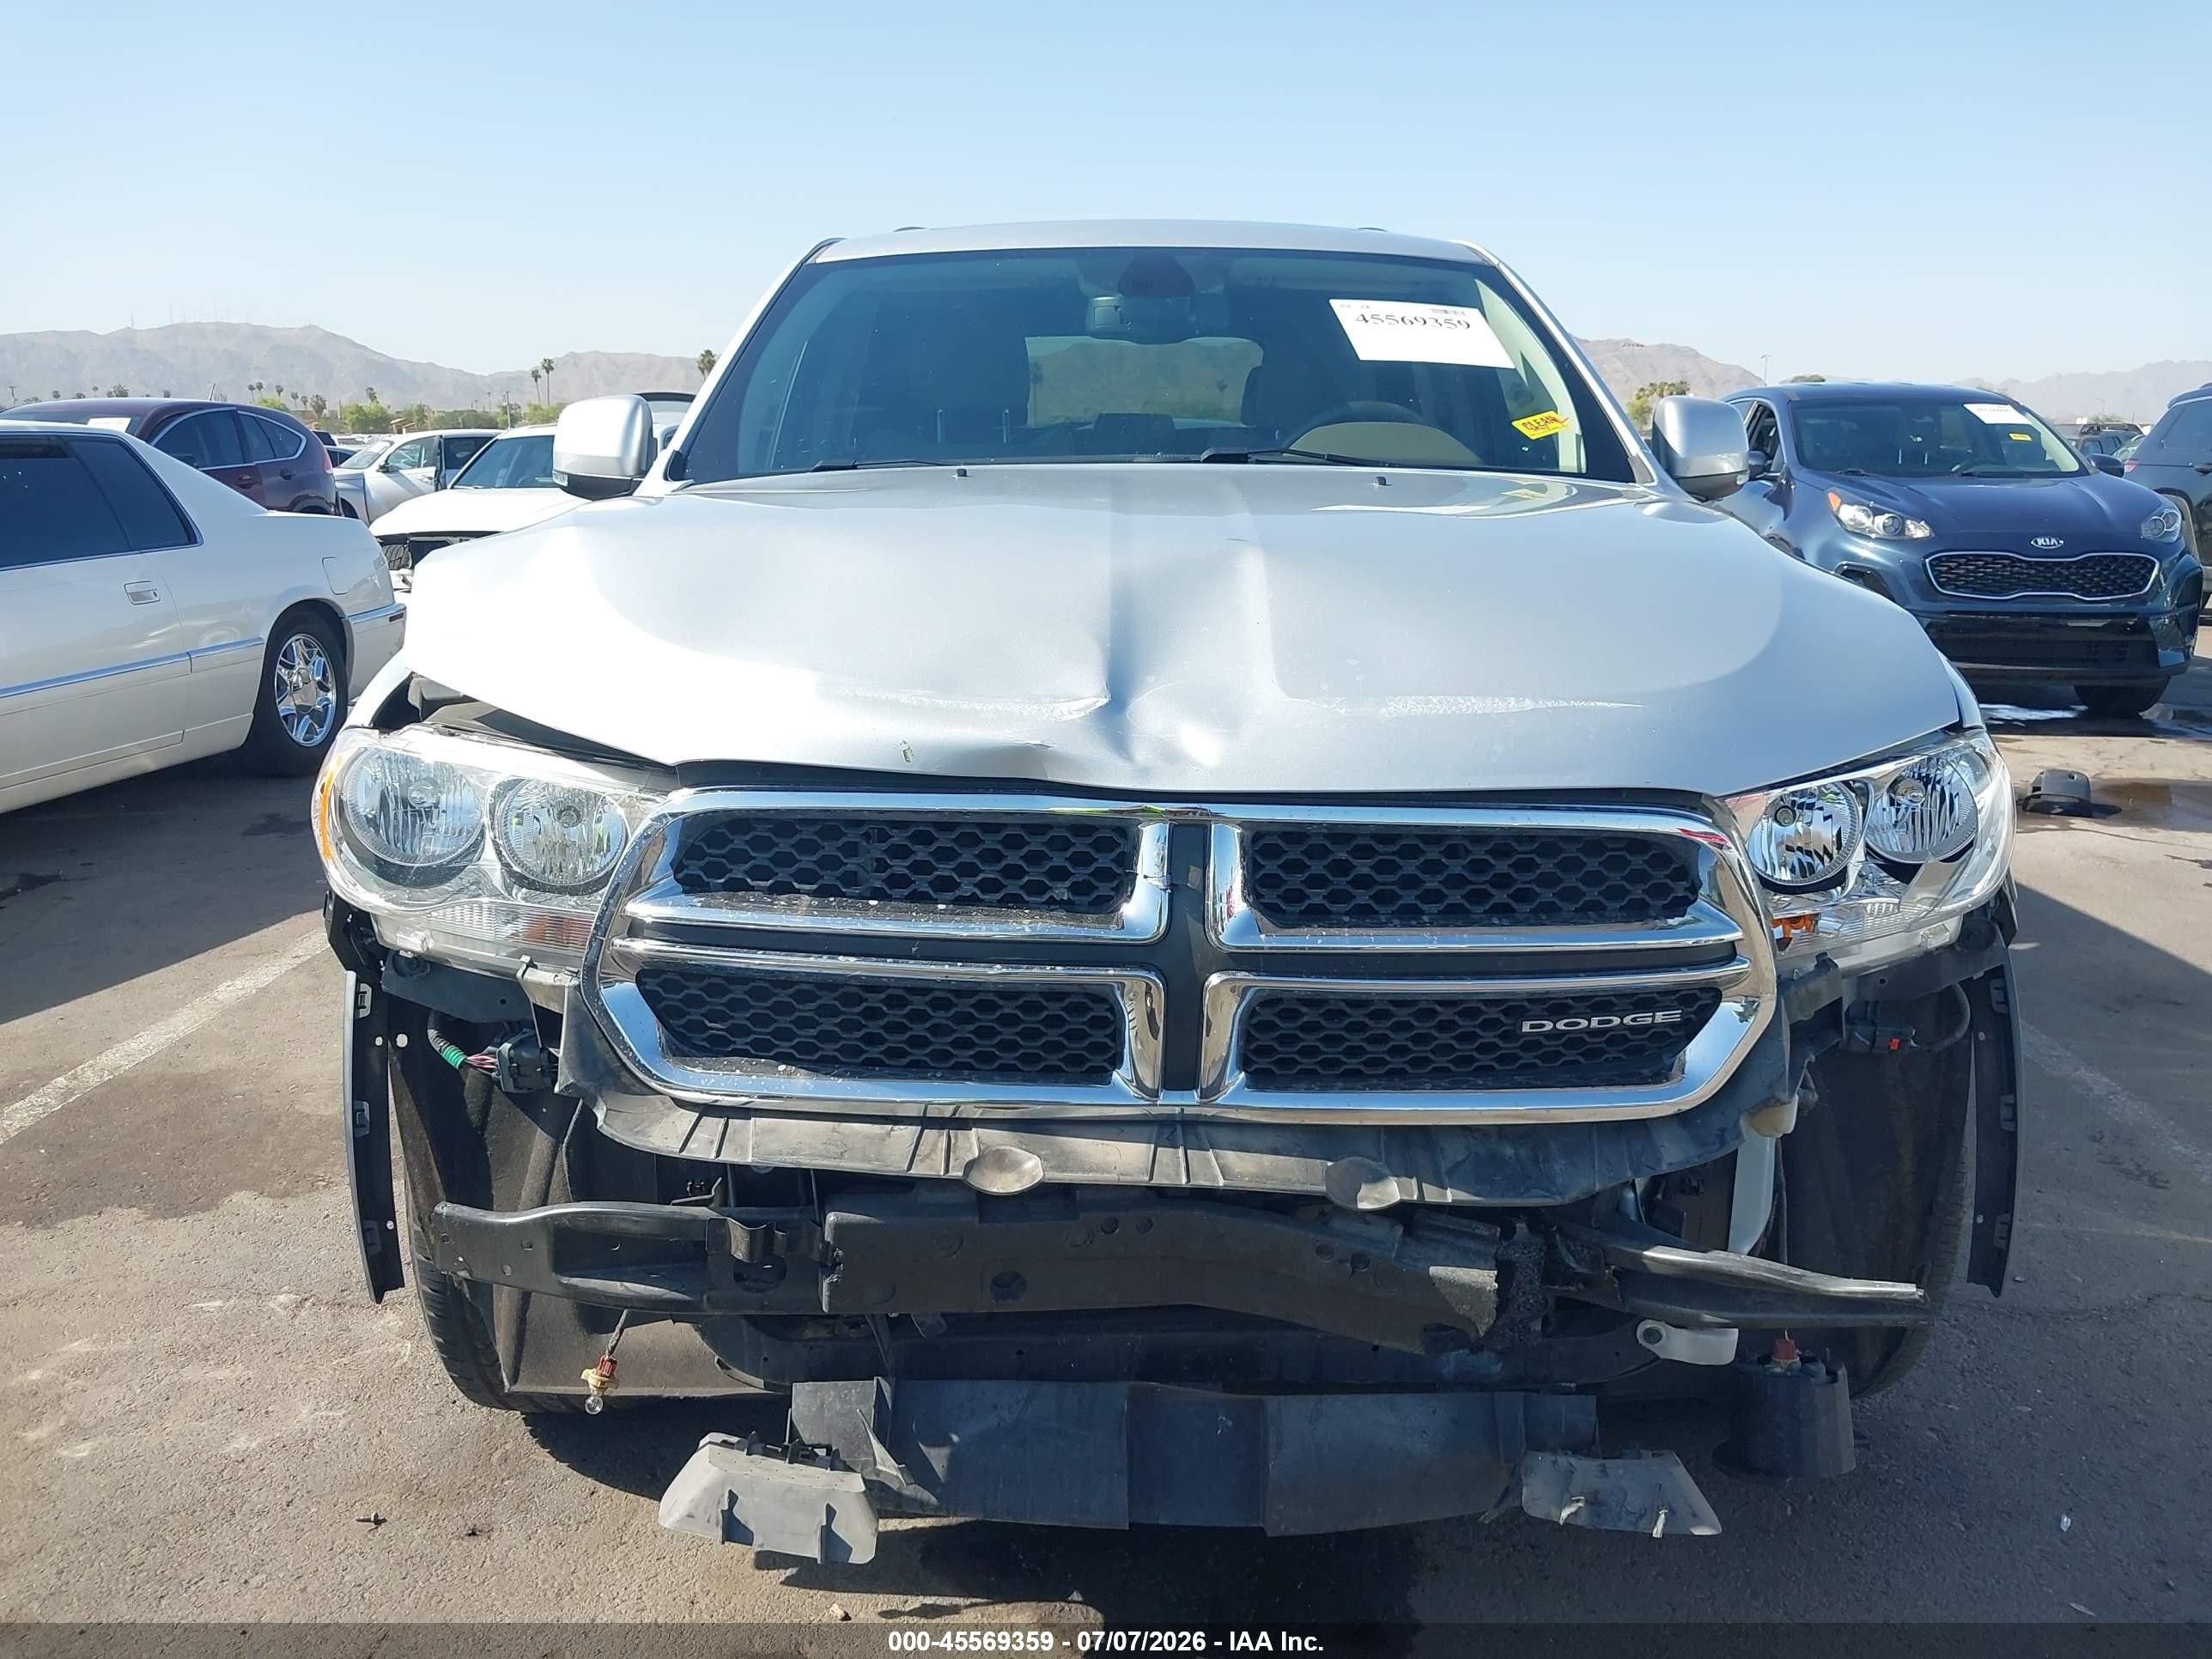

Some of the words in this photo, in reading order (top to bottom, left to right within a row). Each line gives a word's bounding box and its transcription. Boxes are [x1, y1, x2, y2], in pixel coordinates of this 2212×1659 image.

[1355, 313, 1471, 331] 45569359
[2036, 538, 2058, 546] KIA
[1522, 1010, 1682, 1032] DODGE
